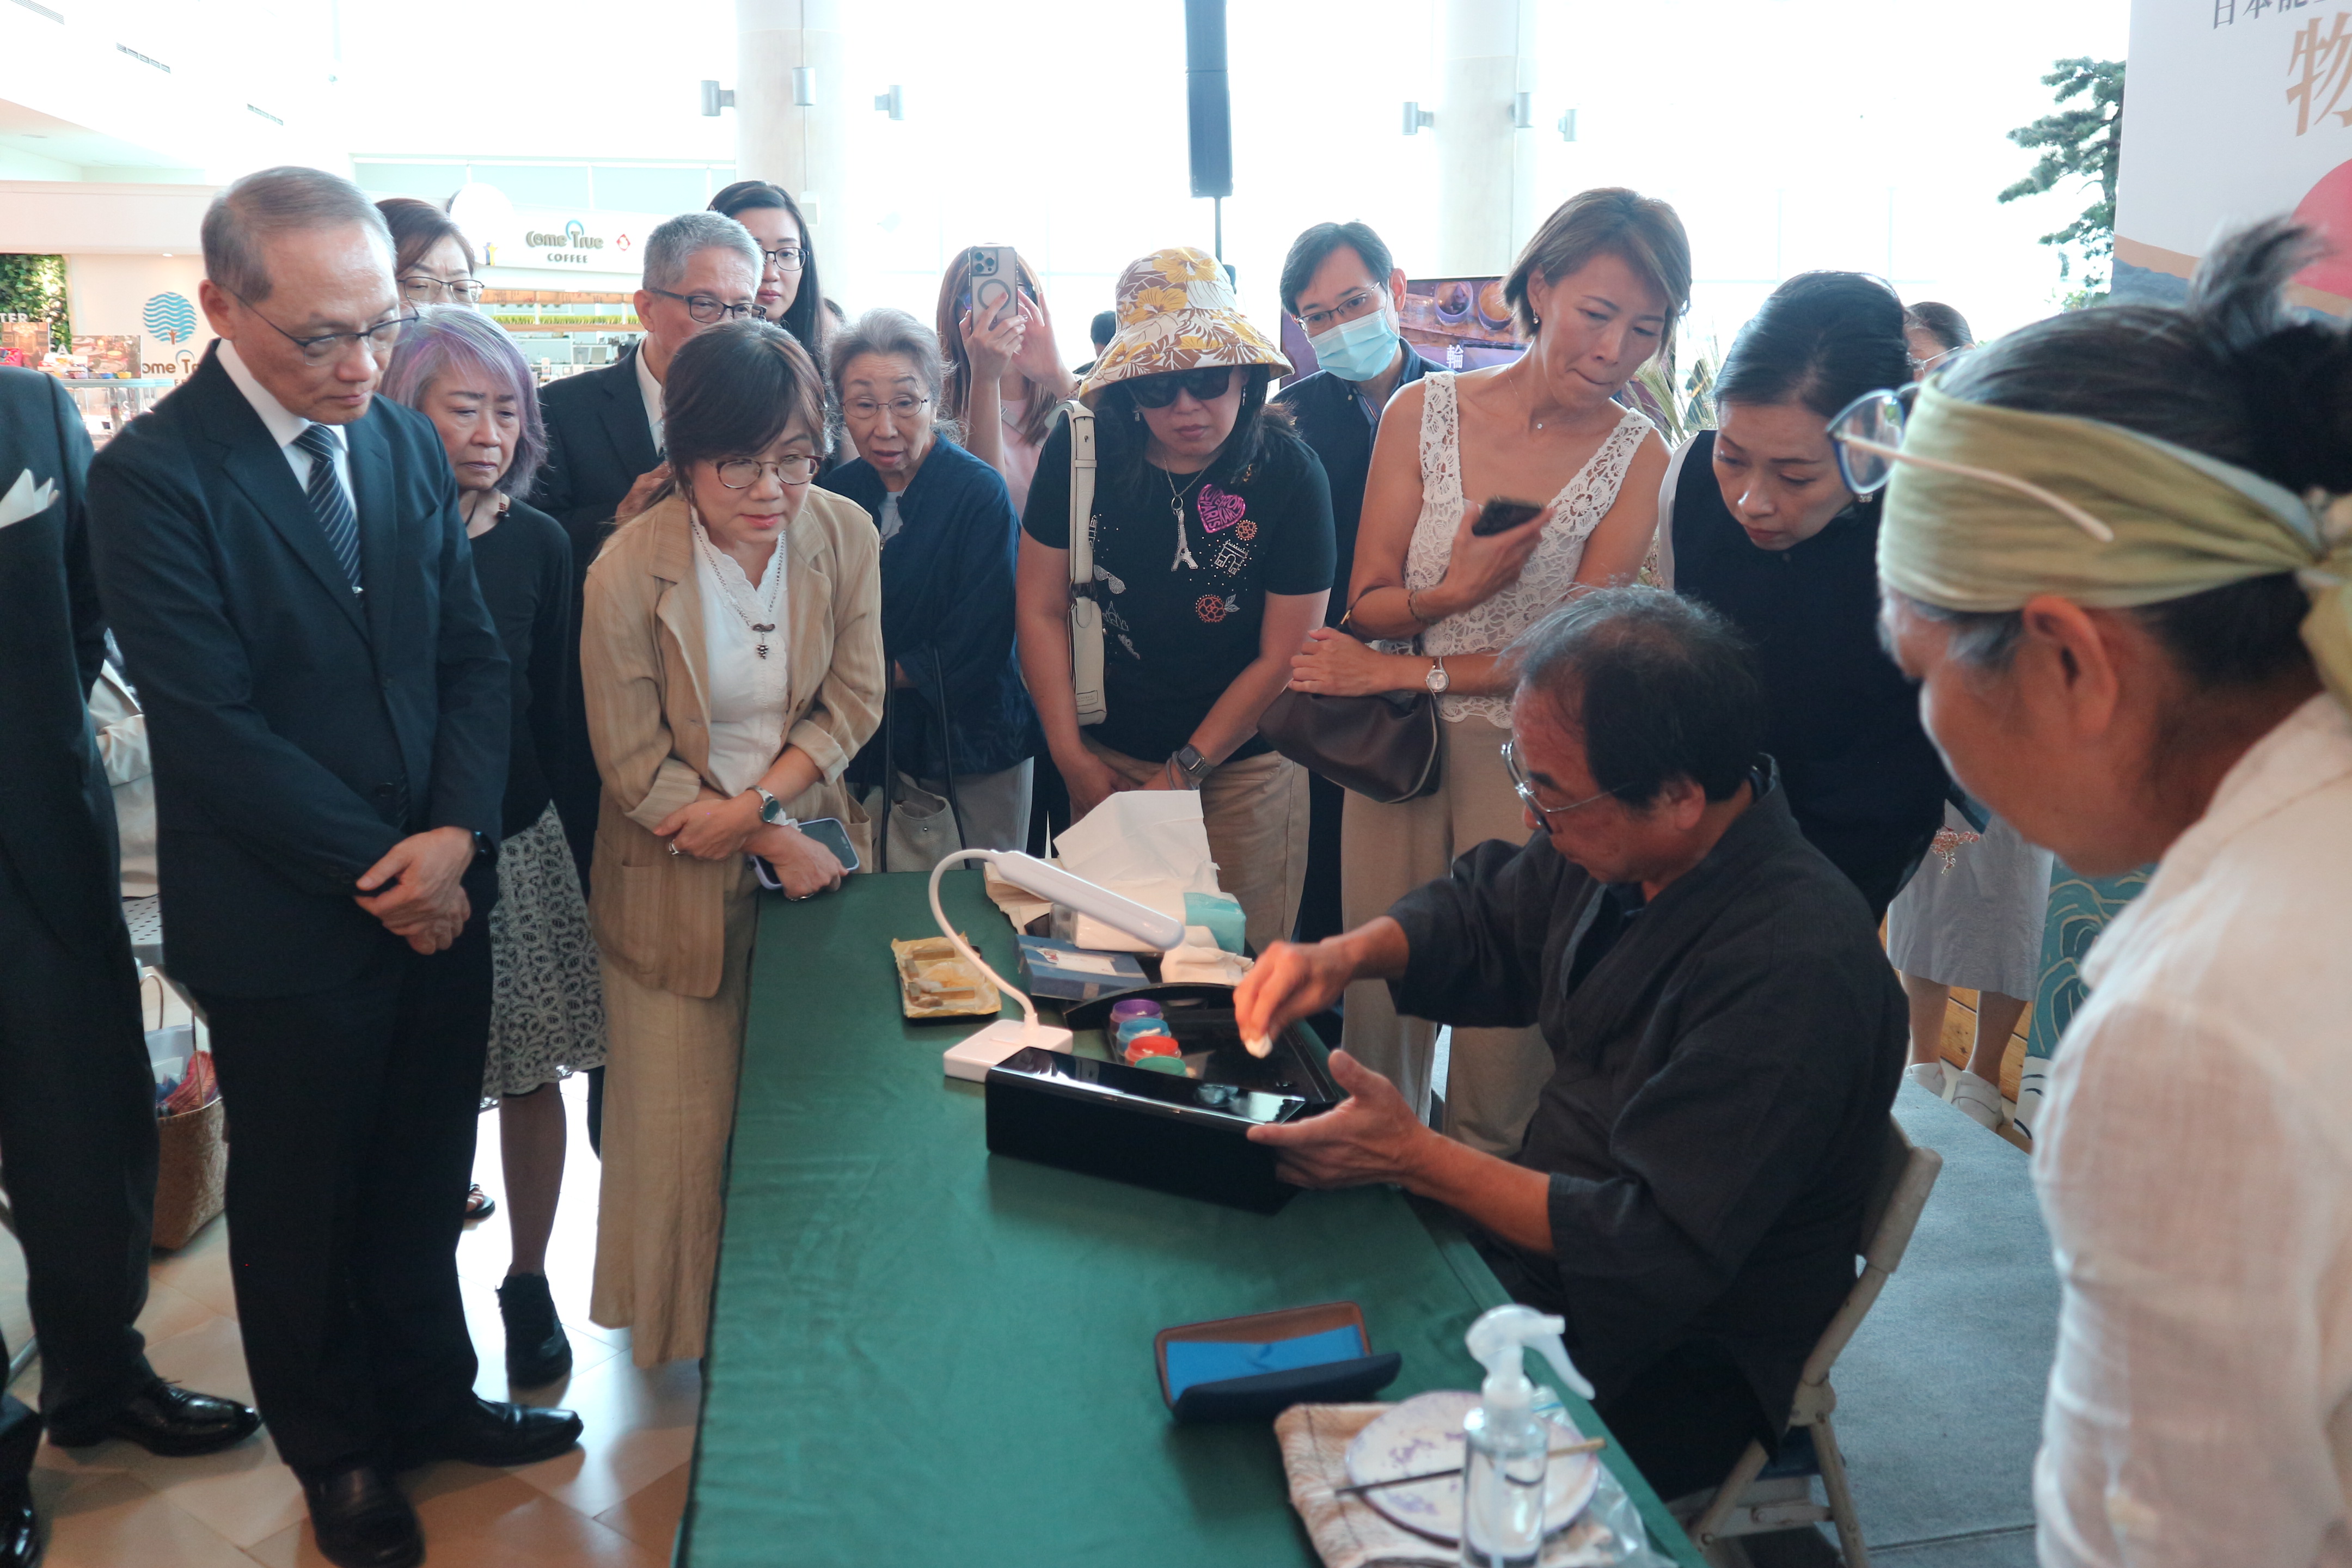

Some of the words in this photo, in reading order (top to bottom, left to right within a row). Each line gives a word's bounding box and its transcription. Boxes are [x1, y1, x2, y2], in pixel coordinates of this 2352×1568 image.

[2286, 12, 2352, 137] 物
[526, 230, 567, 248] Come
[571, 231, 604, 249] True
[547, 253, 588, 264] COFFEE
[1446, 344, 1464, 369] 輪
[142, 363, 176, 374] ome
[1200, 488, 1222, 506] LOVE
[1218, 495, 1243, 513] FROM
[1200, 500, 1221, 529] PARIS
